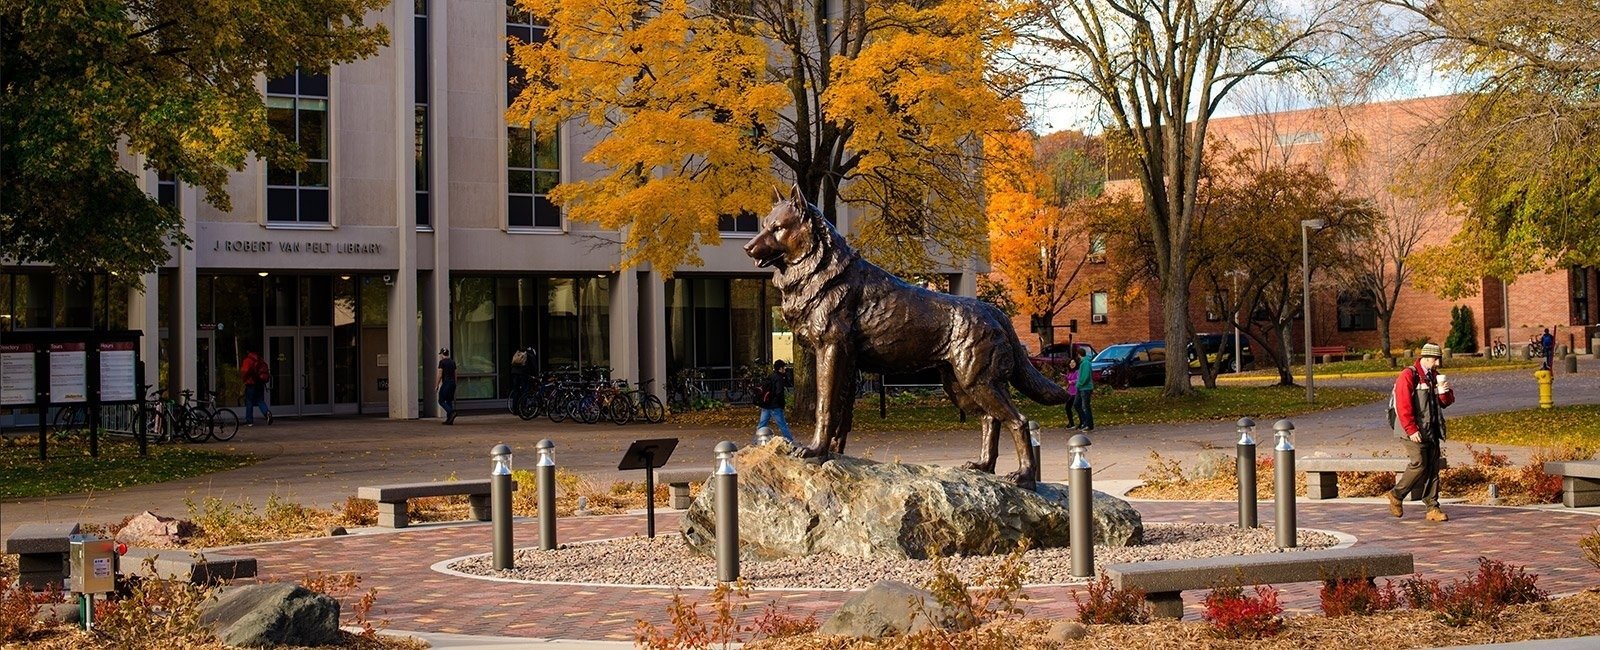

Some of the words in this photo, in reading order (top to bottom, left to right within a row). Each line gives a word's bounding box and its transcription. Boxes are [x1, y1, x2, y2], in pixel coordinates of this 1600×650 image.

[213, 240, 219, 252] J
[225, 240, 273, 253] ROBERT
[279, 241, 300, 253] VAN
[305, 242, 332, 254] PELT
[336, 242, 383, 255] LIBRARY
